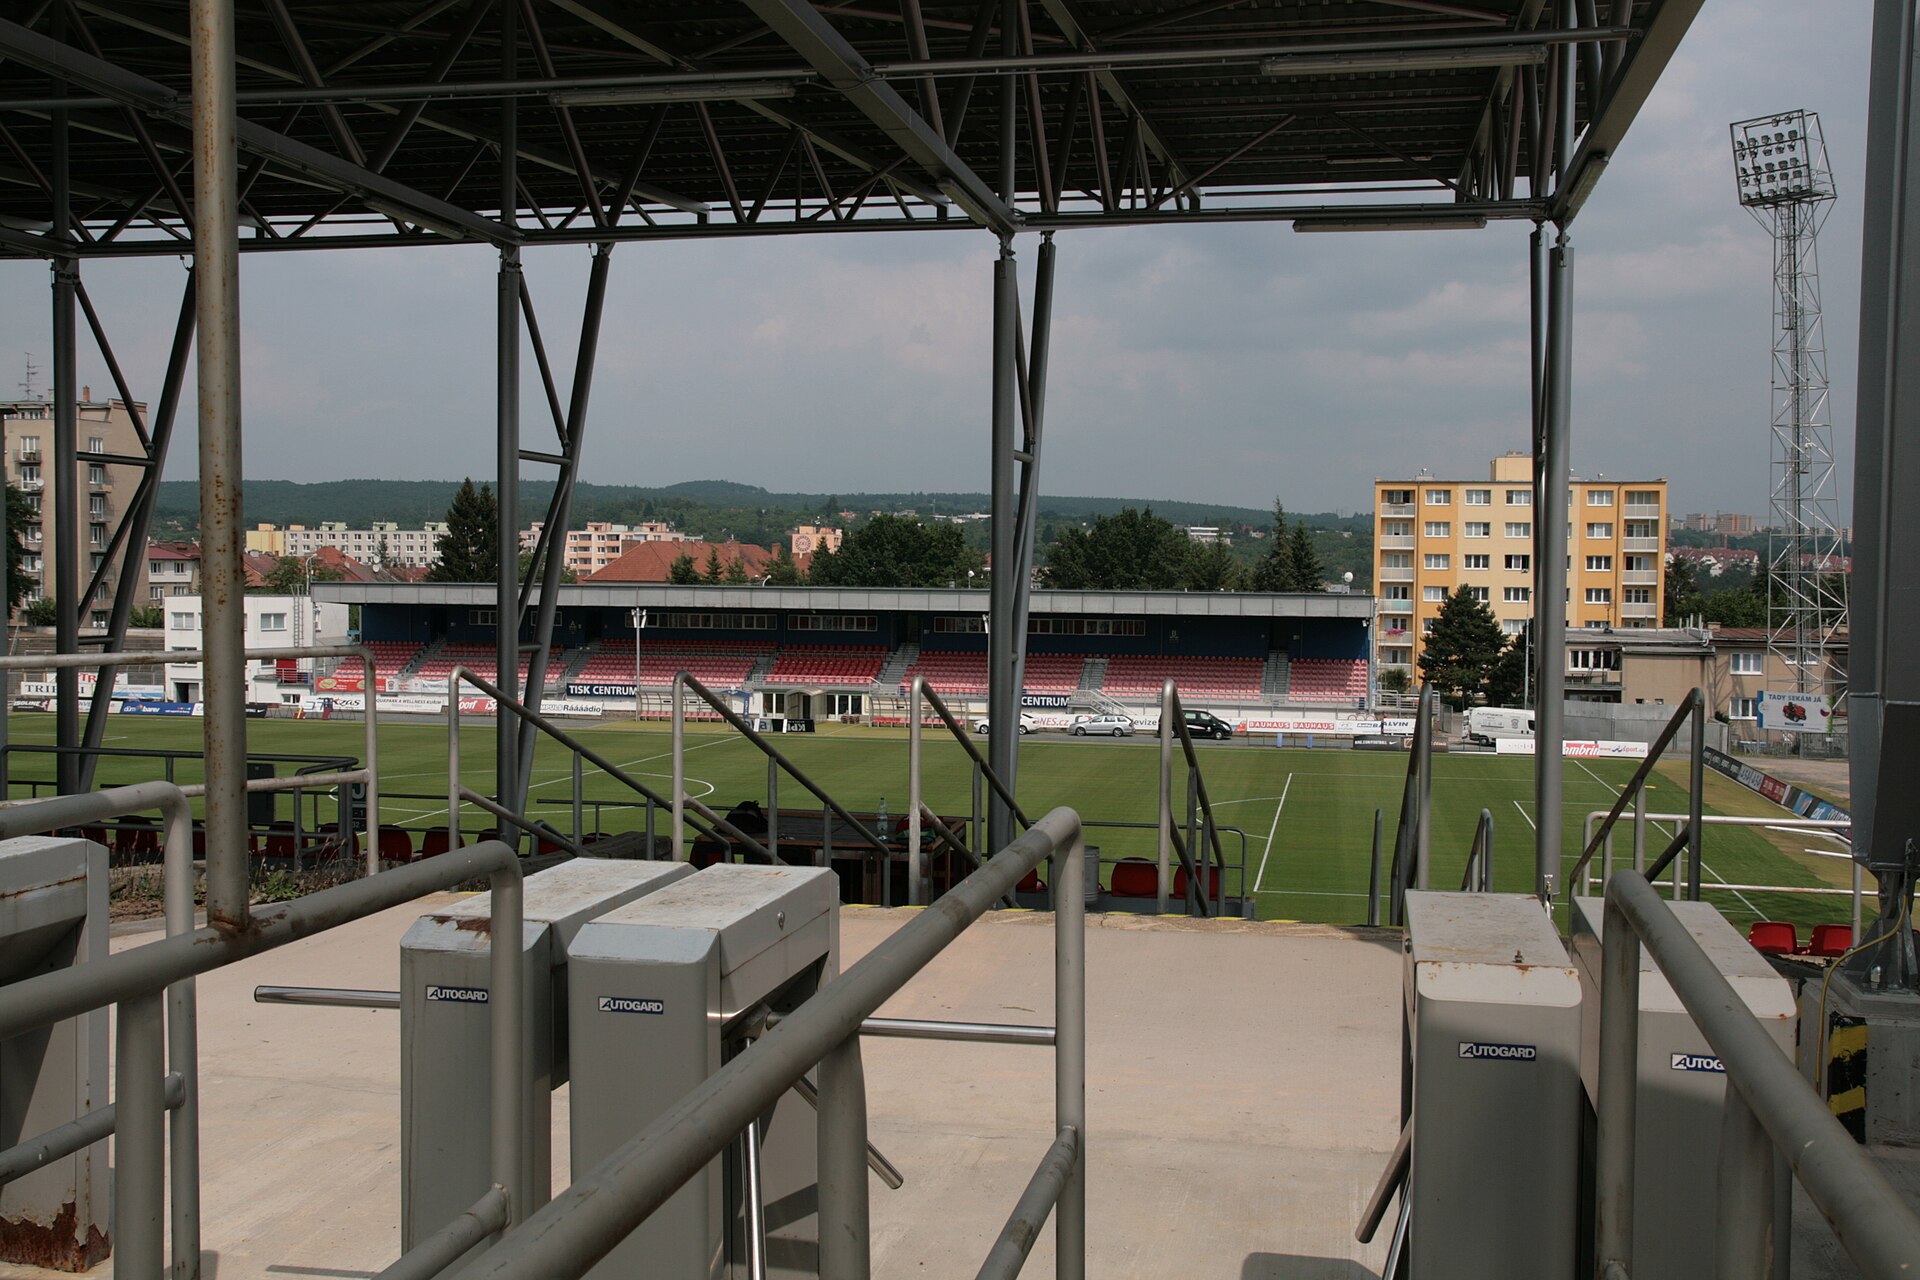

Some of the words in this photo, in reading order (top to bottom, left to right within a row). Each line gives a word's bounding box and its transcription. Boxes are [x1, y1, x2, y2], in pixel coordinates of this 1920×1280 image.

[569, 685, 590, 694] TISK
[592, 686, 637, 695] CENTRUM
[1021, 696, 1069, 706] CENTRUM
[1788, 694, 1812, 702] SEKÁM
[1039, 717, 1069, 726] NES.cz
[1249, 721, 1290, 729] BAUHAUS
[1293, 722, 1334, 730] BAUHAUS
[428, 987, 488, 1001] AUTOGARD
[600, 998, 663, 1013] AUTOGARD
[1460, 1043, 1535, 1059] AUTOGARD
[1673, 1055, 1725, 1070] AUTOG
